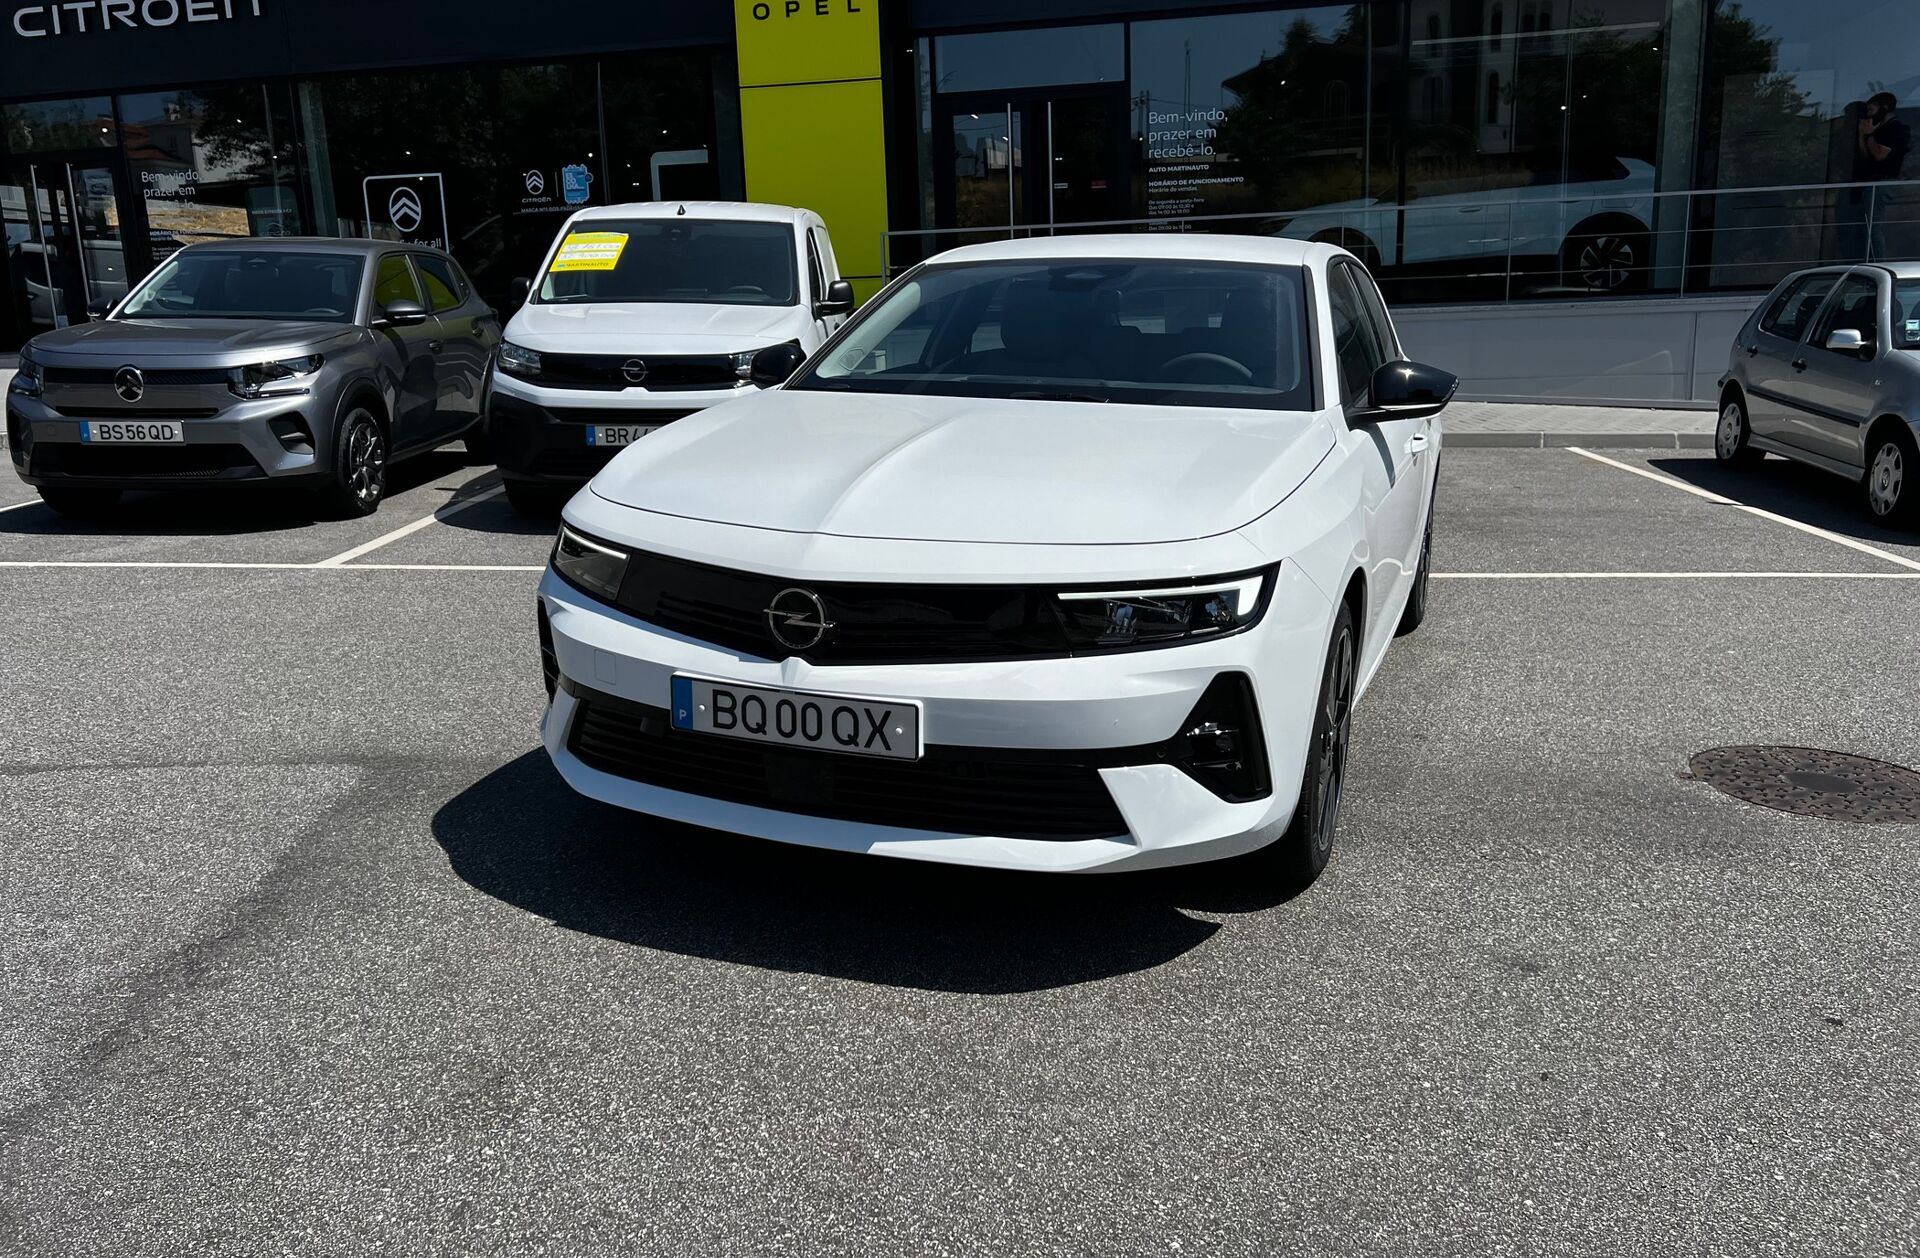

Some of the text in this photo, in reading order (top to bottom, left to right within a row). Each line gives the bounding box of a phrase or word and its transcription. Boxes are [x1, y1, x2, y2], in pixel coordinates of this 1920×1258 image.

[753, 0, 860, 20] OPEL
[1149, 108, 1228, 124] Bem-vindo,
[1149, 128, 1217, 144] prazer em
[1149, 143, 1217, 158] recebê-lo.
[1167, 164, 1209, 172] MARTINAUTO
[1149, 179, 1178, 188] HORÁRIO
[1189, 176, 1245, 185] FUNCIONAMENTO
[178, 186, 196, 196] em
[431, 237, 442, 248] all
[679, 708, 687, 720] P
